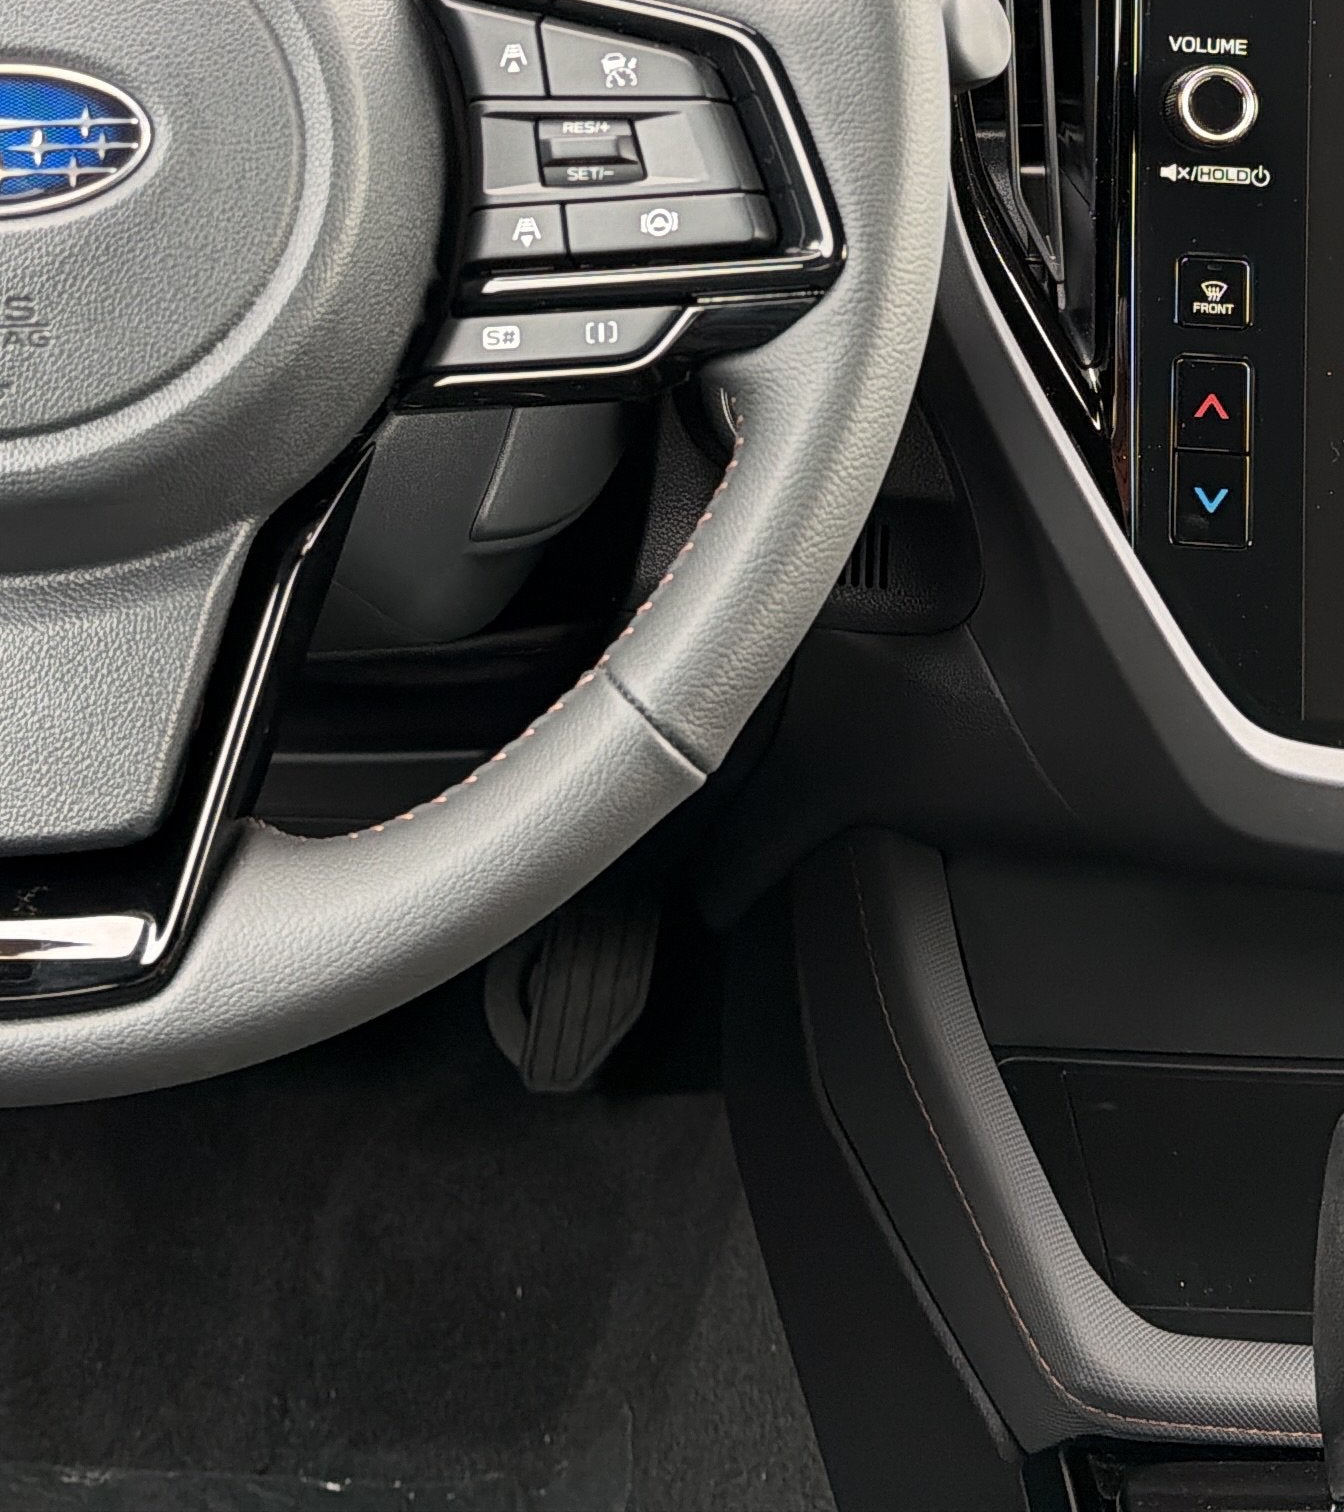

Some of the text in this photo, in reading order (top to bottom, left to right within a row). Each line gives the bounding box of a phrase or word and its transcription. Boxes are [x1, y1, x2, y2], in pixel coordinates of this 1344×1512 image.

[1168, 35, 1249, 56] VOLUME
[1199, 167, 1250, 184] HOLD
[1192, 301, 1235, 316] FRONT
